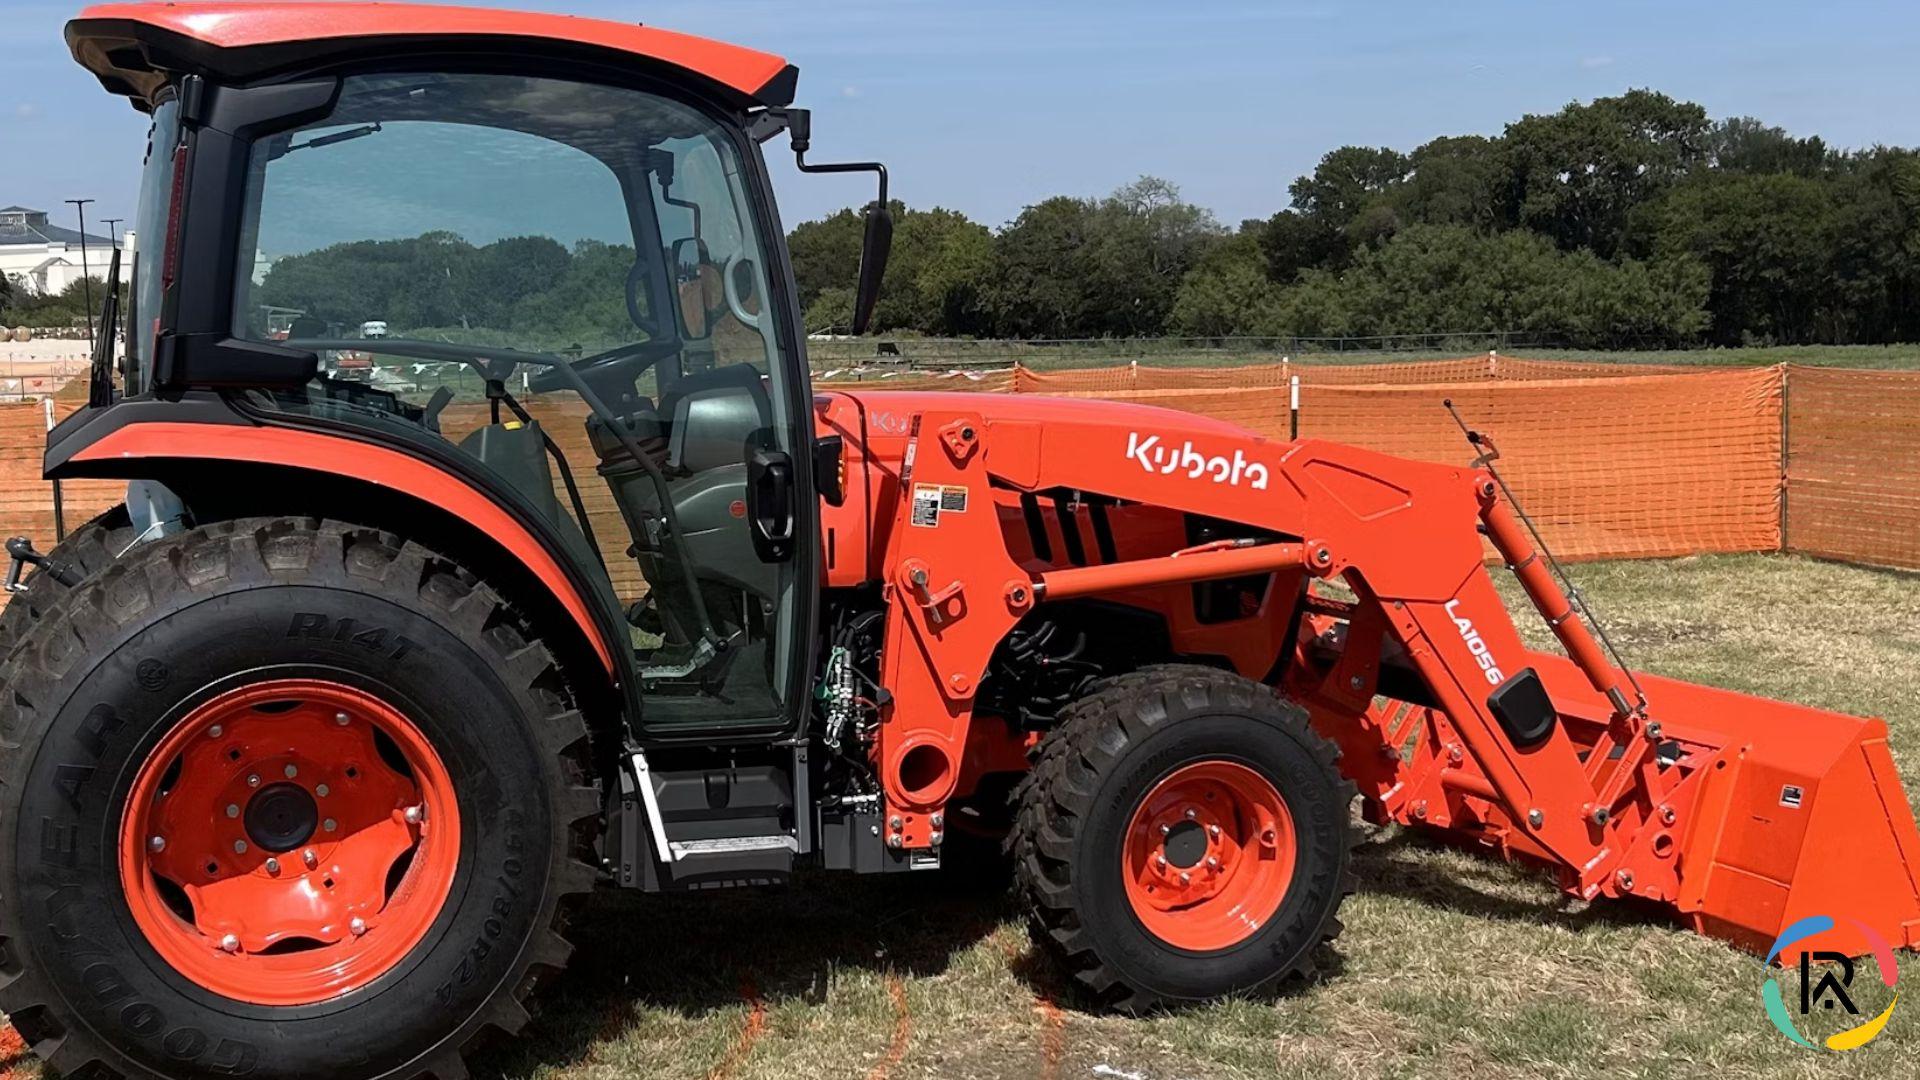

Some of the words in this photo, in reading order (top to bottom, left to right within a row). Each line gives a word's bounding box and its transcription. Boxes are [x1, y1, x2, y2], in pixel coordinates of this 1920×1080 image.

[870, 410, 906, 432] Ku
[1125, 431, 1269, 491] Kubota
[285, 612, 426, 660] R14T
[1444, 599, 1505, 685] LA1056
